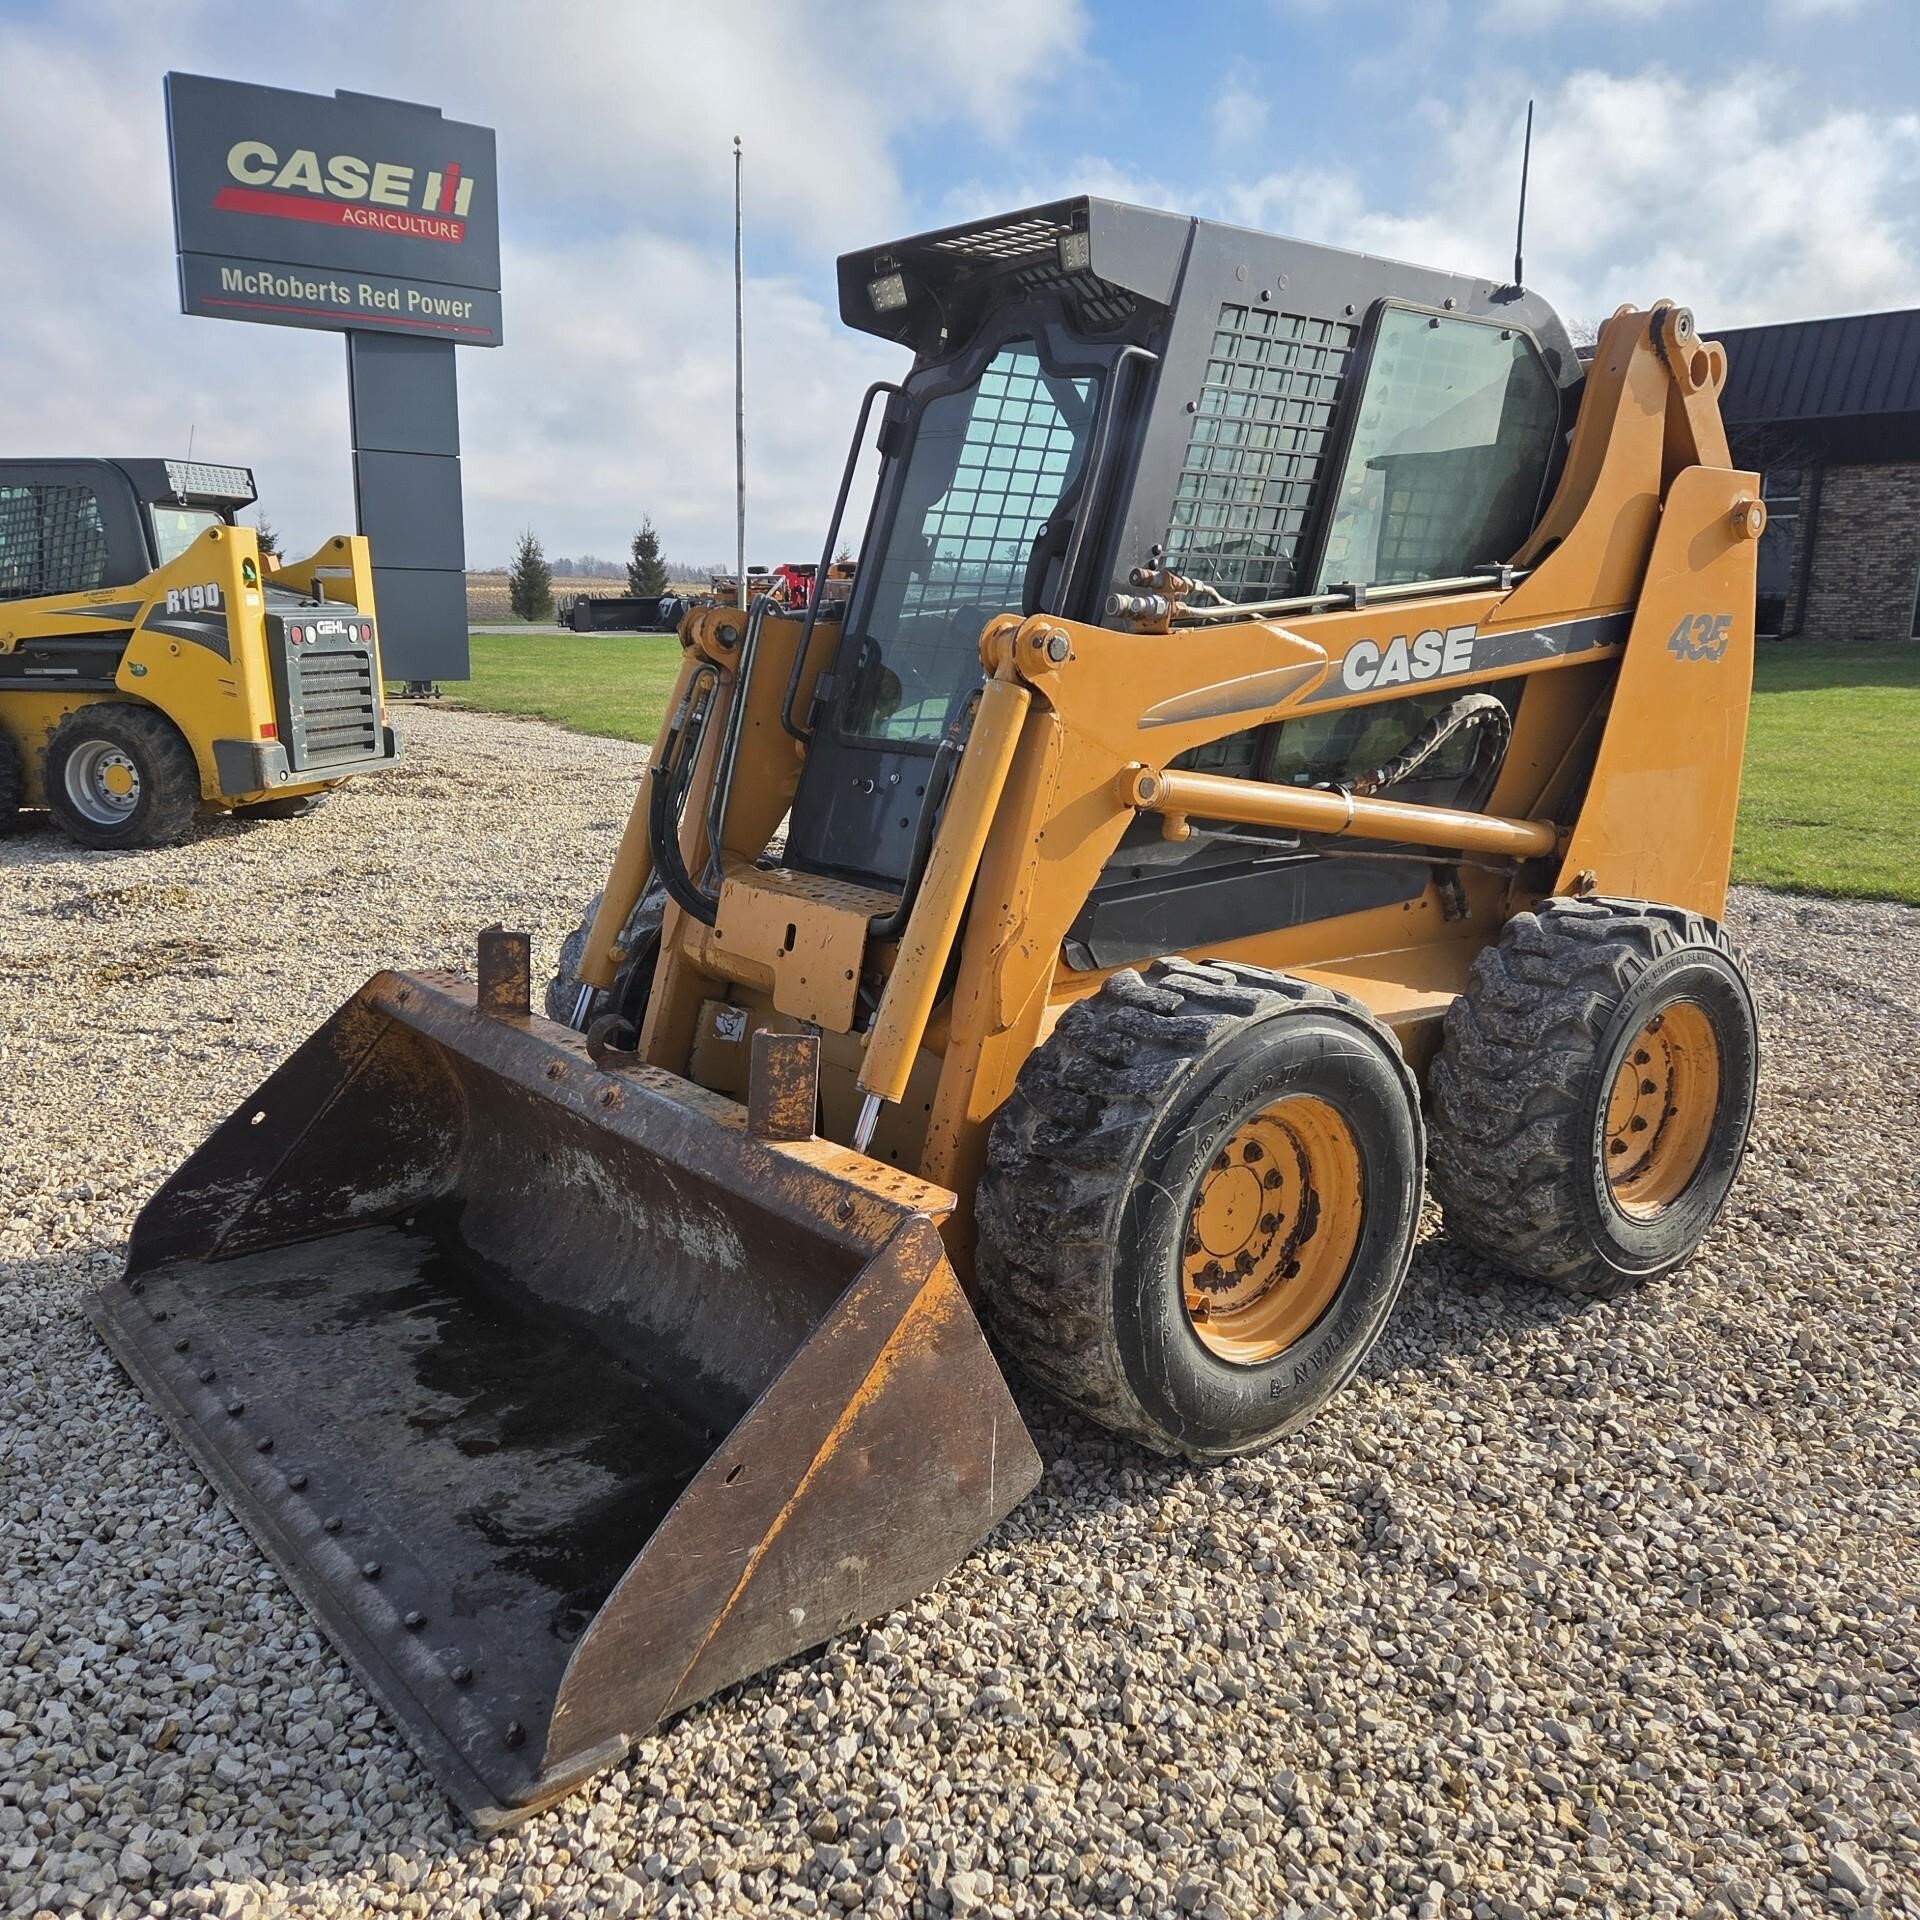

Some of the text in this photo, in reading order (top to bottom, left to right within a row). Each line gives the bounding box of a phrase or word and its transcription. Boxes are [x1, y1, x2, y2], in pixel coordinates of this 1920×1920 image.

[227, 141, 414, 207] CASE
[342, 208, 460, 238] AGRICULTURE
[221, 267, 472, 318] McRoberts Red Power
[166, 582, 220, 614] R190
[316, 620, 347, 634] GEHL
[1667, 613, 1733, 661] 435
[1342, 624, 1477, 691] CASE
[1634, 977, 1652, 997] FOR
